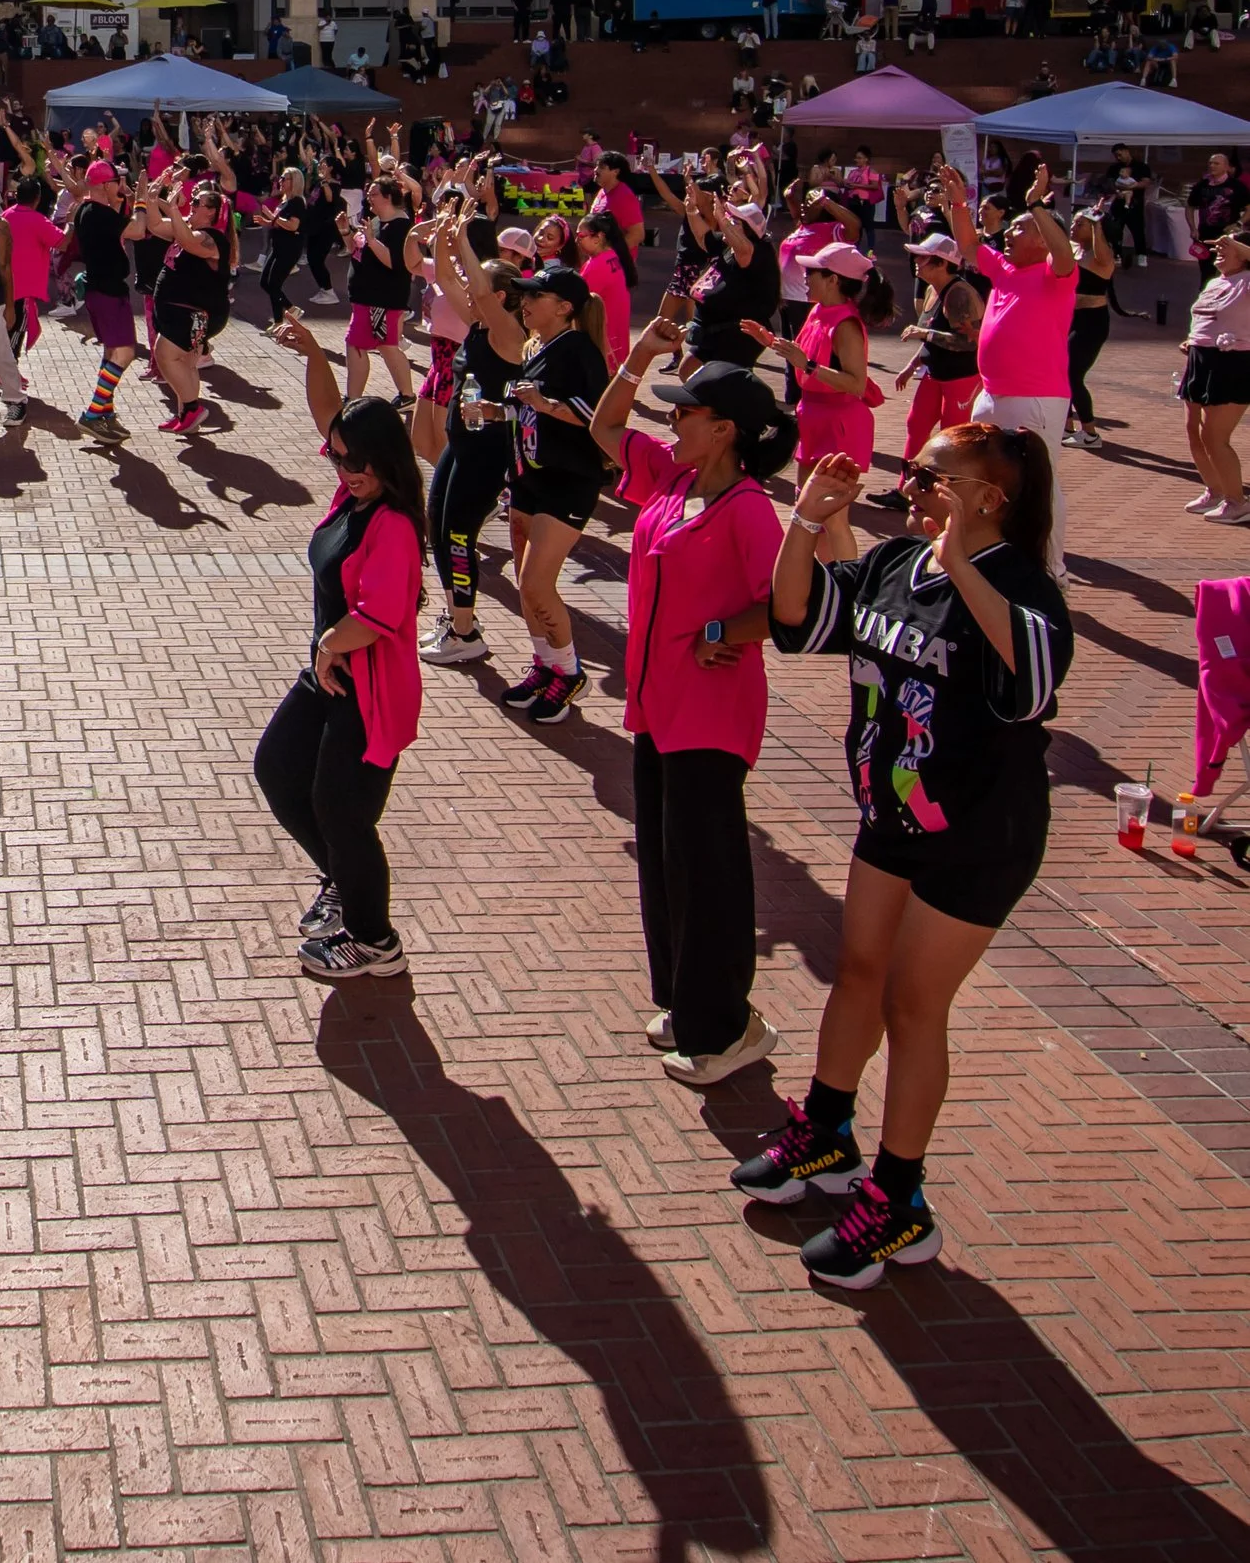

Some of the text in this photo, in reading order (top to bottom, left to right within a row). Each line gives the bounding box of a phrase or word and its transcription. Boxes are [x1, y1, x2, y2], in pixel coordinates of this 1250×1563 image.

[98, 15, 127, 24] BLOCK
[450, 533, 471, 596] ZUMBA
[853, 602, 949, 677] UMBA
[790, 1149, 846, 1180] ZUMBA
[871, 1223, 923, 1263] ZUMBA
